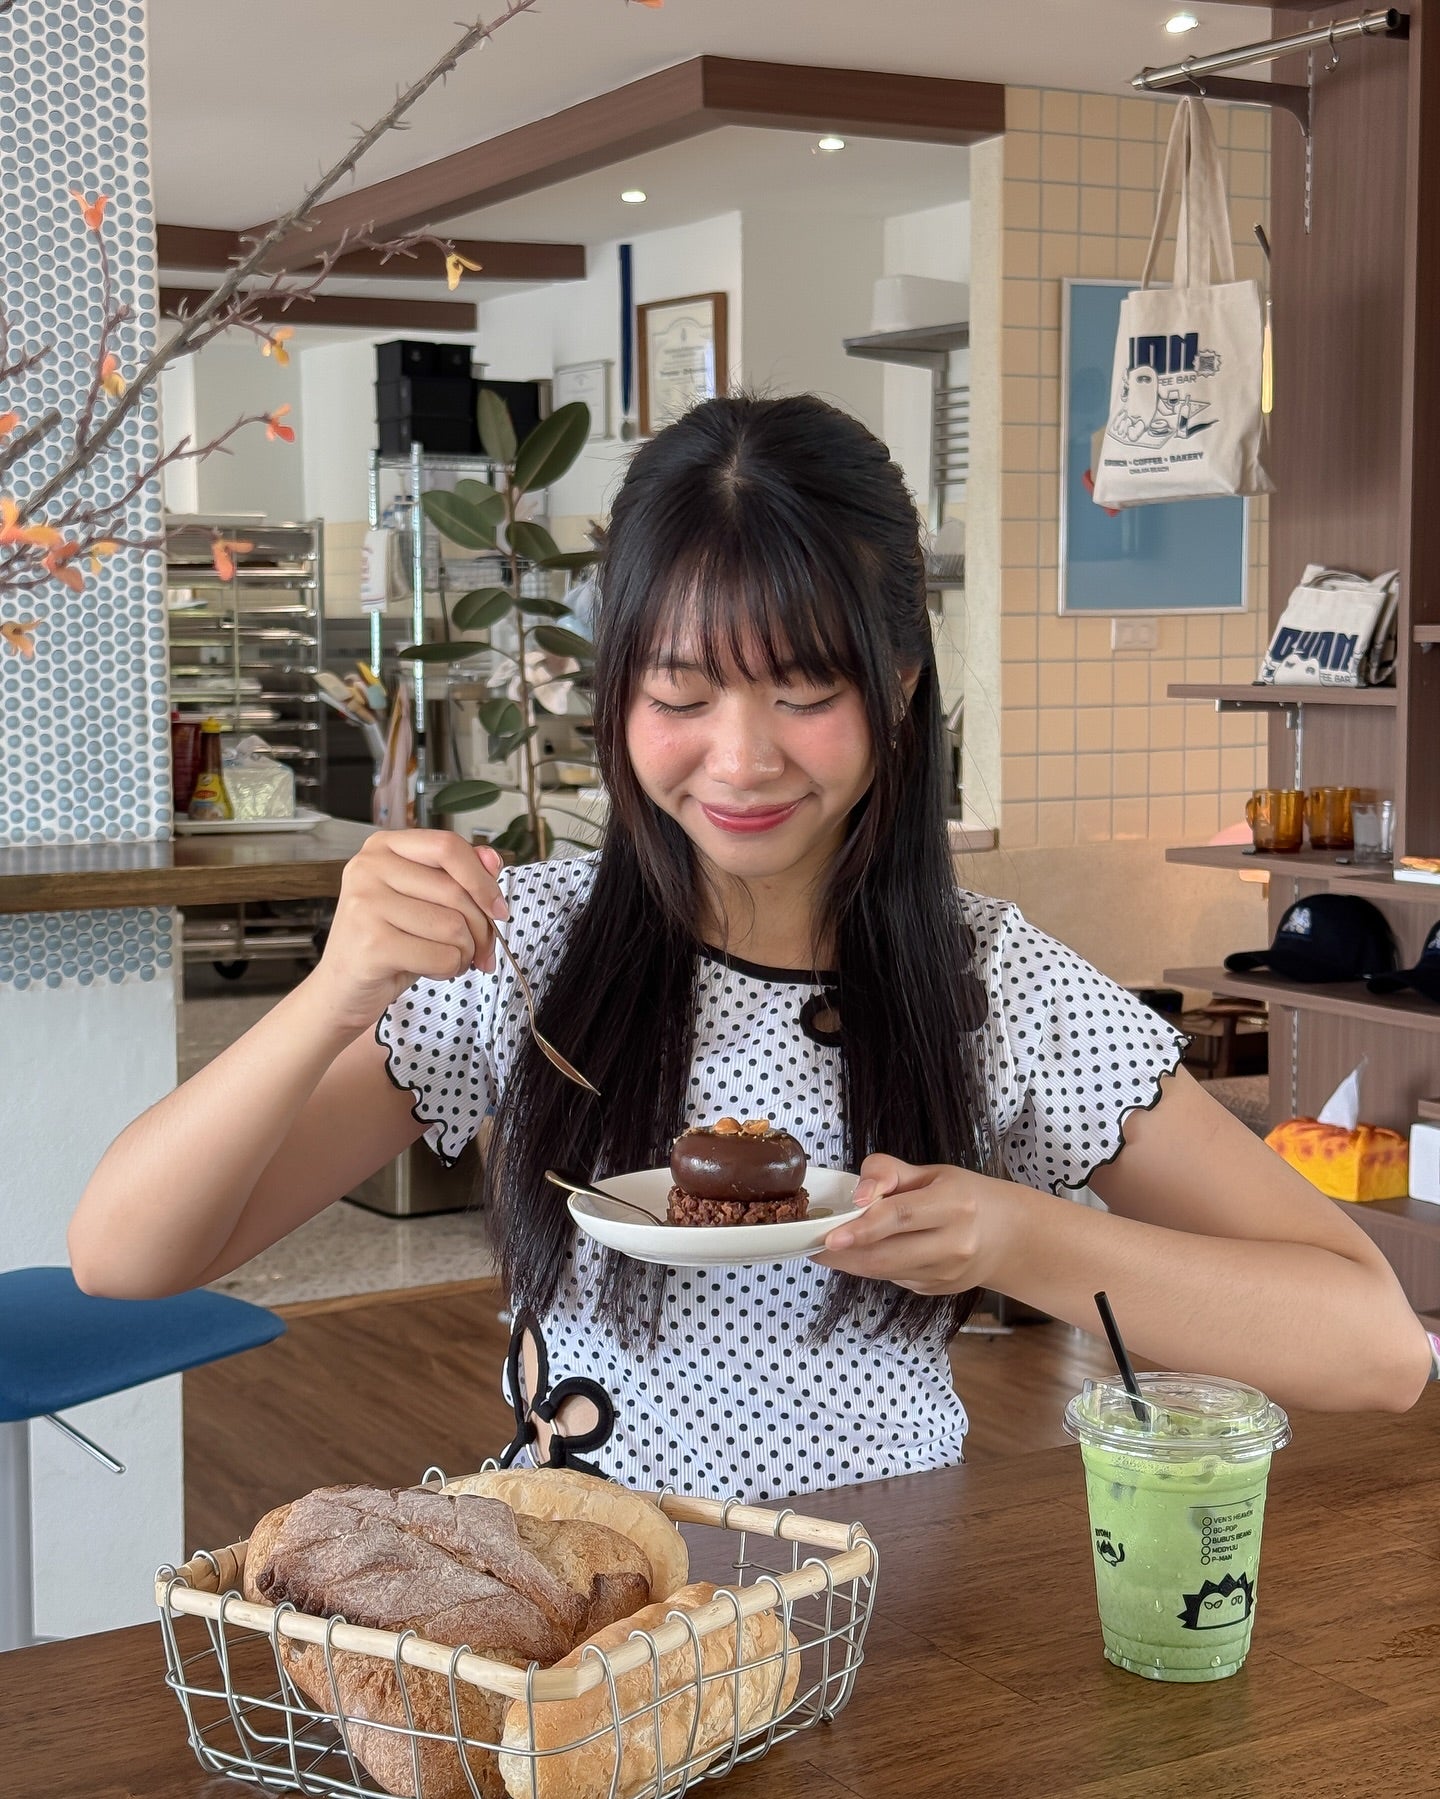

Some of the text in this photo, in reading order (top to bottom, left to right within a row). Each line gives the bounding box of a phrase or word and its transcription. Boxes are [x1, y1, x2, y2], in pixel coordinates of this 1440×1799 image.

[1176, 374, 1197, 385] BAR
[1132, 457, 1163, 466] COFFEE
[1169, 452, 1204, 464] BAKERY
[1213, 1524, 1238, 1534] BO-POP
[1212, 1529, 1252, 1544] BUBU'S BEANS
[1211, 1554, 1233, 1562] P-MAN
